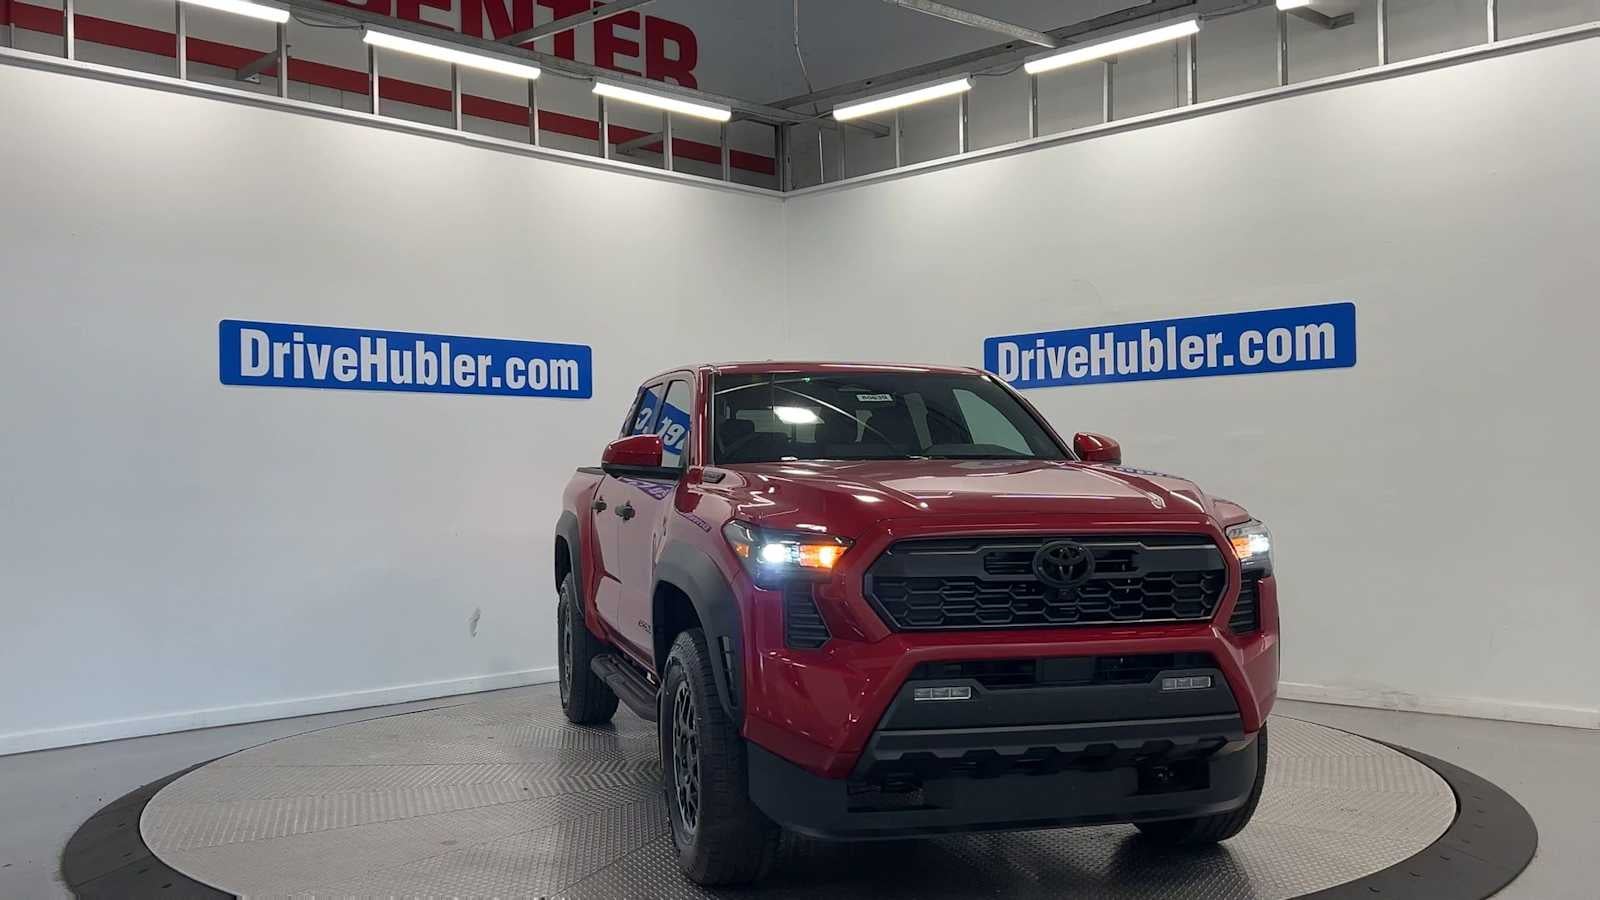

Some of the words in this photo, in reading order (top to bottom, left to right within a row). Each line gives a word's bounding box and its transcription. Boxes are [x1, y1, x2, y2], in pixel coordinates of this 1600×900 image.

[324, 0, 698, 90] NTER
[240, 328, 579, 391] DriveHubler.com
[997, 321, 1336, 383] DriveHubler.com
